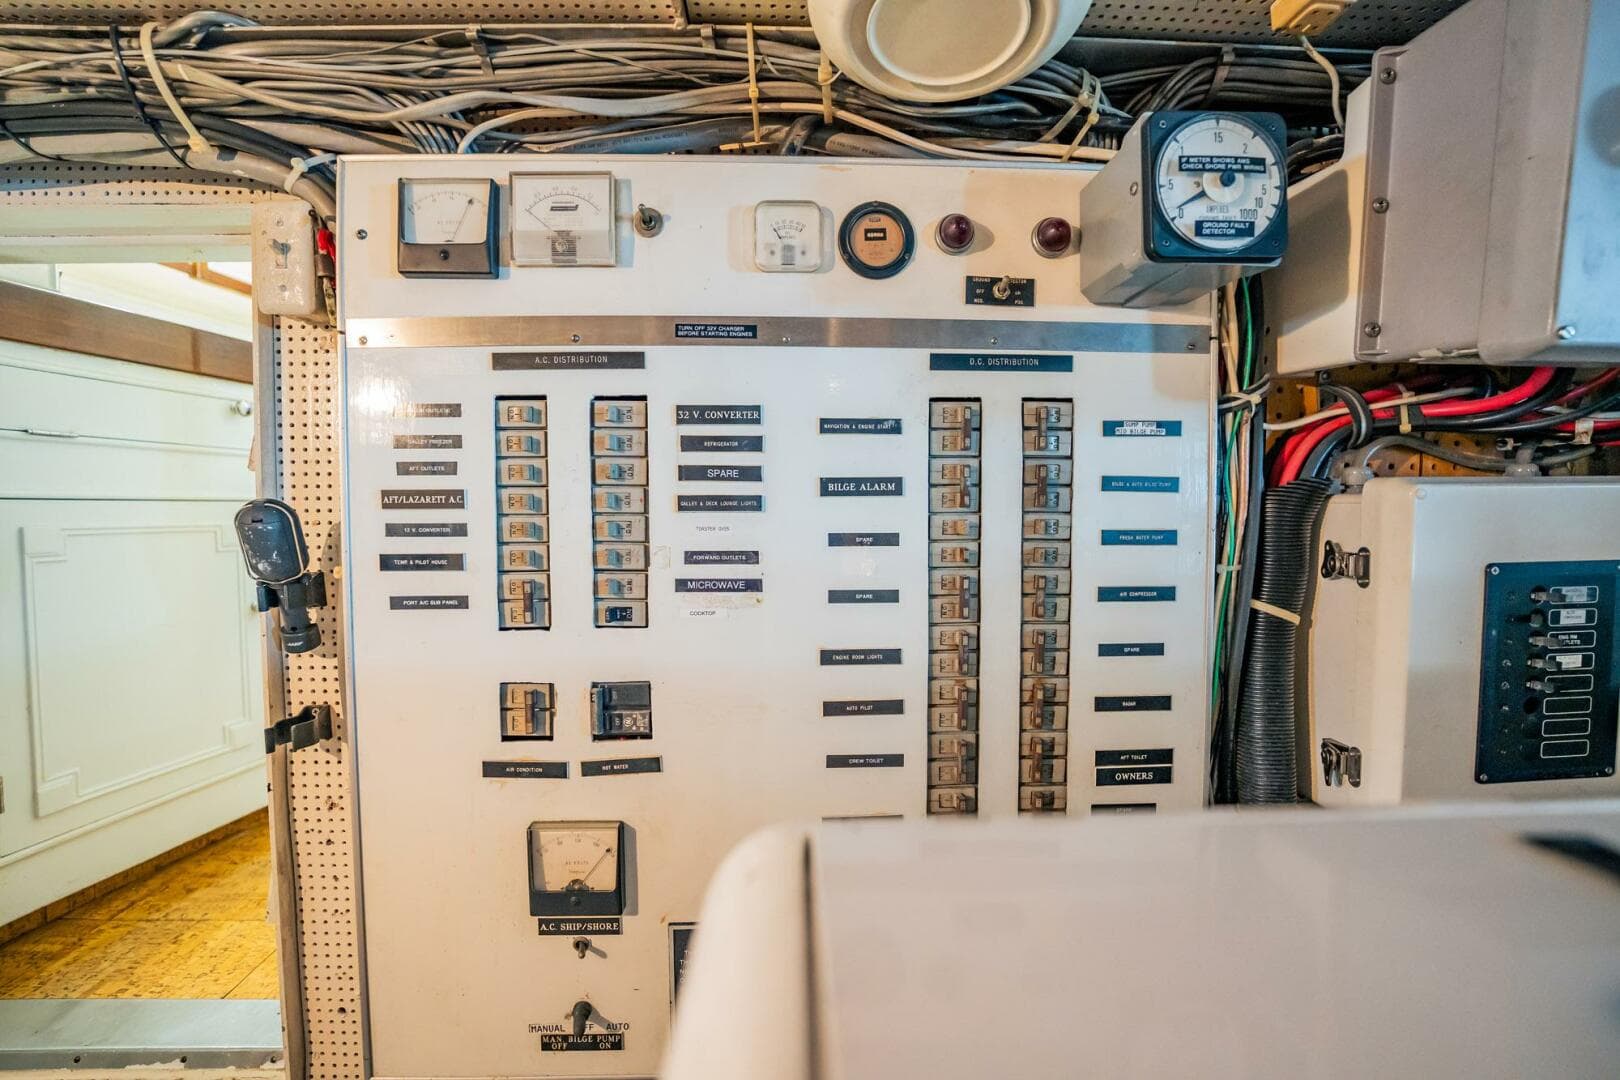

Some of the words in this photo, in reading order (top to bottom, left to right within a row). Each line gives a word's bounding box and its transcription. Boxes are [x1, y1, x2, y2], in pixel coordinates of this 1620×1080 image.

[1243, 143, 1248, 154] 2
[1262, 185, 1267, 195] 5
[1255, 197, 1263, 208] 10
[1178, 208, 1184, 219] 0
[1240, 209, 1258, 220] 1000
[534, 356, 551, 364] A.C.
[553, 355, 608, 364] DISTRIBUTION
[969, 358, 985, 366] D.C.
[988, 358, 1039, 366] DISTRIBUTION
[678, 411, 689, 419] 32
[692, 411, 702, 419] V.
[704, 411, 760, 419] CONVERTER
[707, 468, 740, 478] SPARE
[828, 482, 856, 491] BILGE
[859, 482, 896, 491] ALARM
[383, 495, 446, 504] AFT/LAZARETT
[687, 581, 746, 589] MICROWAVE
[1115, 772, 1154, 781] OWNERS
[560, 922, 619, 931] SHIP/SHORE
[530, 1024, 566, 1033] MANUAL
[606, 1022, 630, 1031] AUTO
[568, 1035, 594, 1043] BILGE
